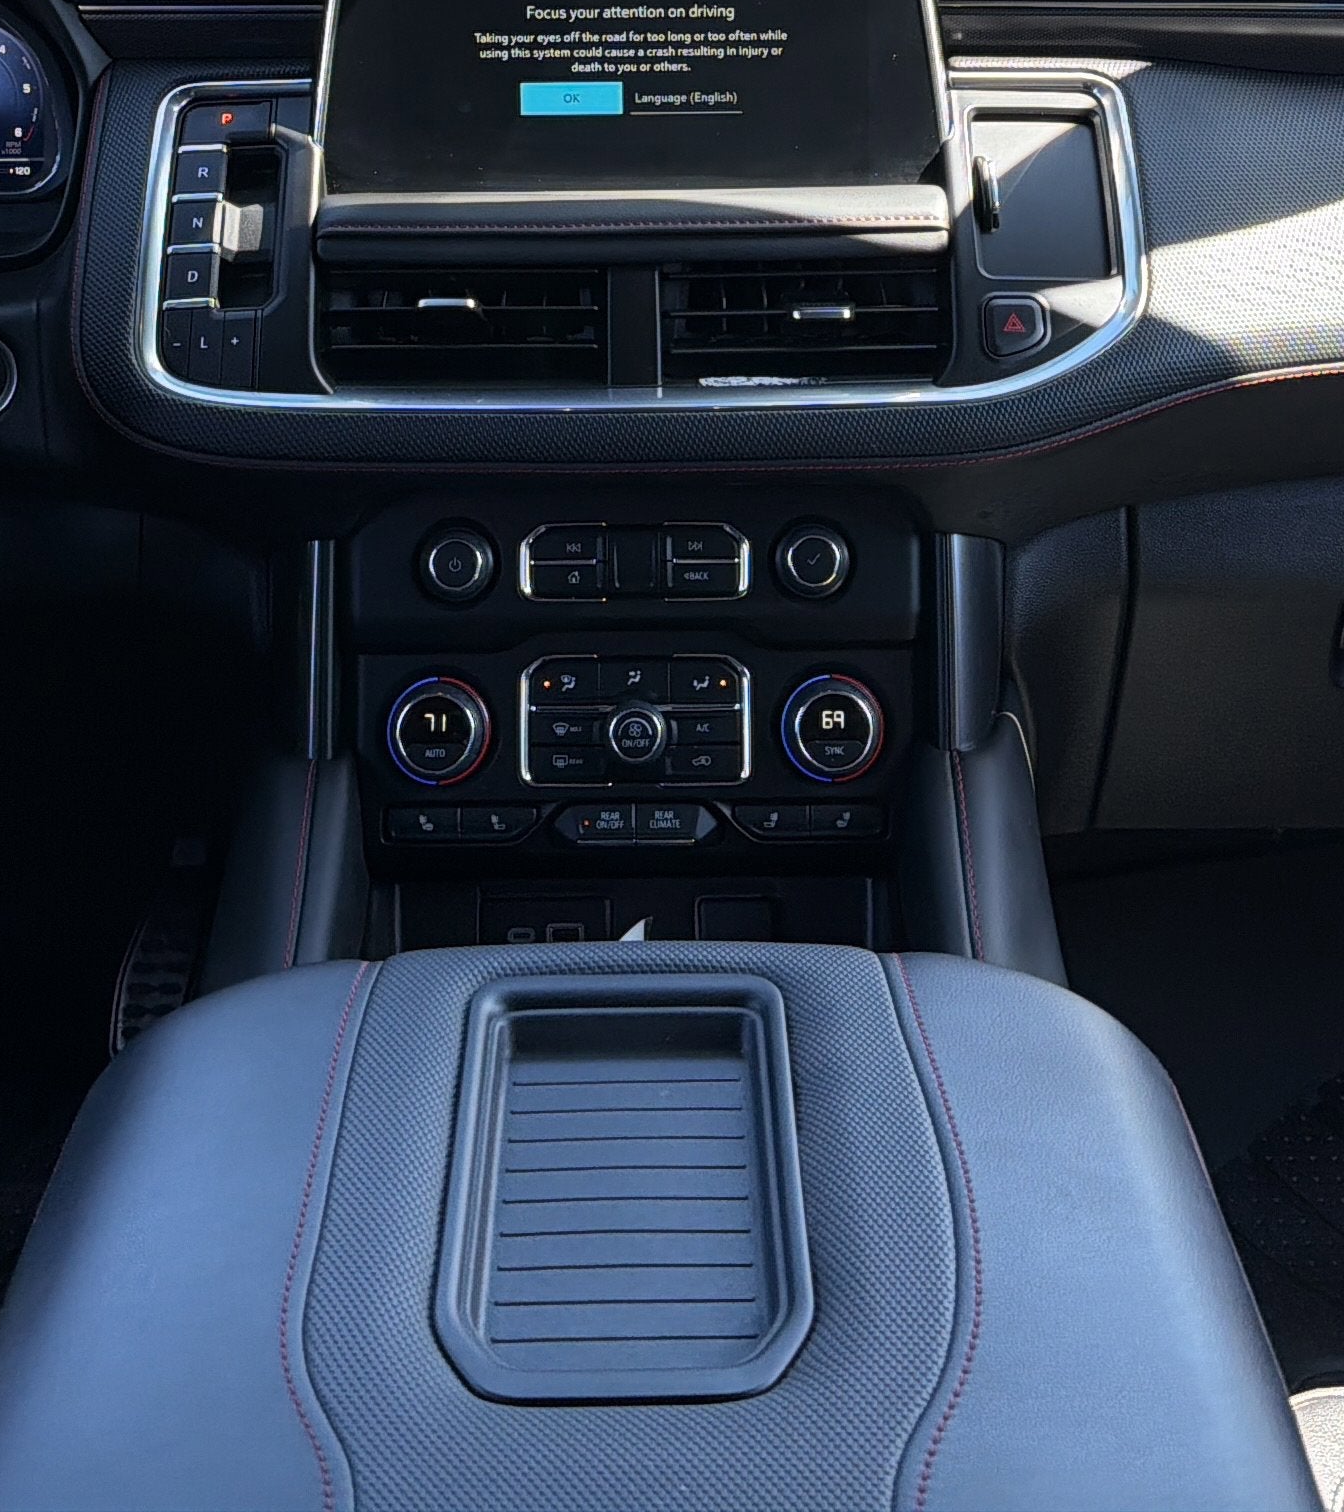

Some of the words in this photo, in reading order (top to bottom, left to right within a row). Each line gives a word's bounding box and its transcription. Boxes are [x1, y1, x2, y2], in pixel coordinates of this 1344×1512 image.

[526, 5, 566, 20] Focus
[569, 8, 599, 22] your
[602, 4, 665, 19] attention
[668, 7, 685, 19] on
[688, 3, 735, 21] driving
[474, 32, 509, 45] Taking
[510, 33, 535, 46] your
[537, 33, 561, 45] eyes
[563, 31, 581, 42] off
[581, 31, 600, 42] the
[602, 31, 626, 42] road
[628, 30, 644, 42] for
[646, 32, 665, 42] too
[667, 30, 692, 45] long
[693, 33, 705, 42] or
[707, 32, 726, 41] too
[728, 30, 757, 41] often
[759, 29, 788, 41] while
[479, 47, 509, 61] using
[510, 46, 530, 58] this
[533, 47, 571, 61] system
[573, 46, 602, 58] could
[604, 48, 635, 58] cause
[646, 46, 676, 57] crash
[677, 45, 725, 59] resulting
[726, 46, 737, 56] in
[739, 45, 768, 58] injury
[770, 47, 783, 56] or
[571, 62, 602, 73] death
[604, 62, 616, 72] to
[617, 63, 637, 75] you
[639, 63, 652, 72] or
[653, 61, 692, 72] others.
[22, 84, 31, 94] 5
[563, 93, 580, 103] OK
[634, 92, 688, 106] Language
[689, 91, 738, 106] (English)
[220, 112, 233, 125] P
[14, 128, 23, 138] 6
[15, 166, 31, 176] 120
[197, 167, 209, 179] R
[192, 216, 204, 229] N
[187, 270, 199, 283] D
[200, 336, 209, 349] L
[689, 571, 709, 581] BACK
[424, 713, 447, 733] 71
[822, 710, 845, 730] 69
[696, 724, 710, 733] A/C
[621, 739, 651, 748] ON/OFF
[424, 748, 446, 758] AUTO
[824, 746, 845, 756] SYNC
[600, 811, 621, 820] REAR
[654, 810, 674, 819] REAR
[595, 820, 625, 830] ON/OFF
[649, 819, 681, 830] CLIMATE
